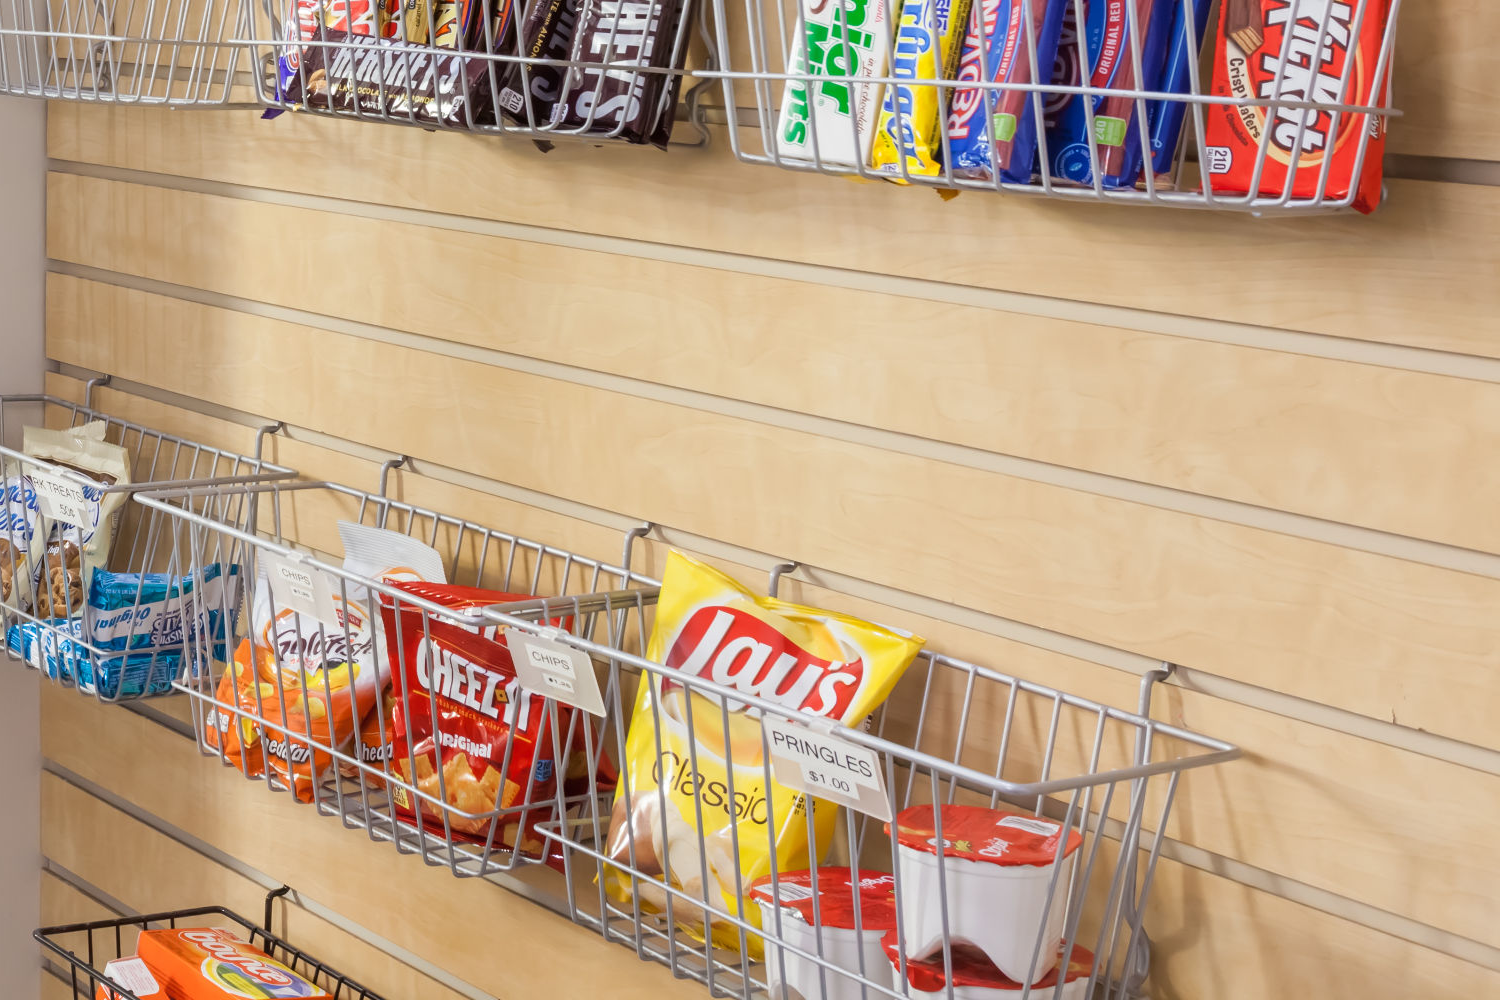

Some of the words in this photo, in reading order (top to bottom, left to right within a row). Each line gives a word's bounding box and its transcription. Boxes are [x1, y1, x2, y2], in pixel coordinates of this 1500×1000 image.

[526, 23, 547, 72] ALMONS
[999, 26, 1017, 76] ORIGINAL
[1099, 26, 1120, 76] ORIGINAL
[1110, 1, 1121, 25] RED
[330, 31, 471, 95] HERSHEY'S
[783, 20, 832, 147] Mints
[1230, 57, 1246, 98] Crisp
[511, 96, 522, 112] 210
[1213, 150, 1228, 171] 210
[49, 482, 85, 504] TREATS
[281, 568, 311, 586] CHIPS
[94, 607, 151, 632] Original
[276, 629, 373, 662] Goldfish
[532, 651, 571, 671] CHIPS
[670, 609, 857, 720] Lay's
[772, 731, 873, 778] PRINGLES
[652, 751, 769, 825] Classic
[809, 770, 850, 793] $1.00
[184, 930, 290, 984] bounce
